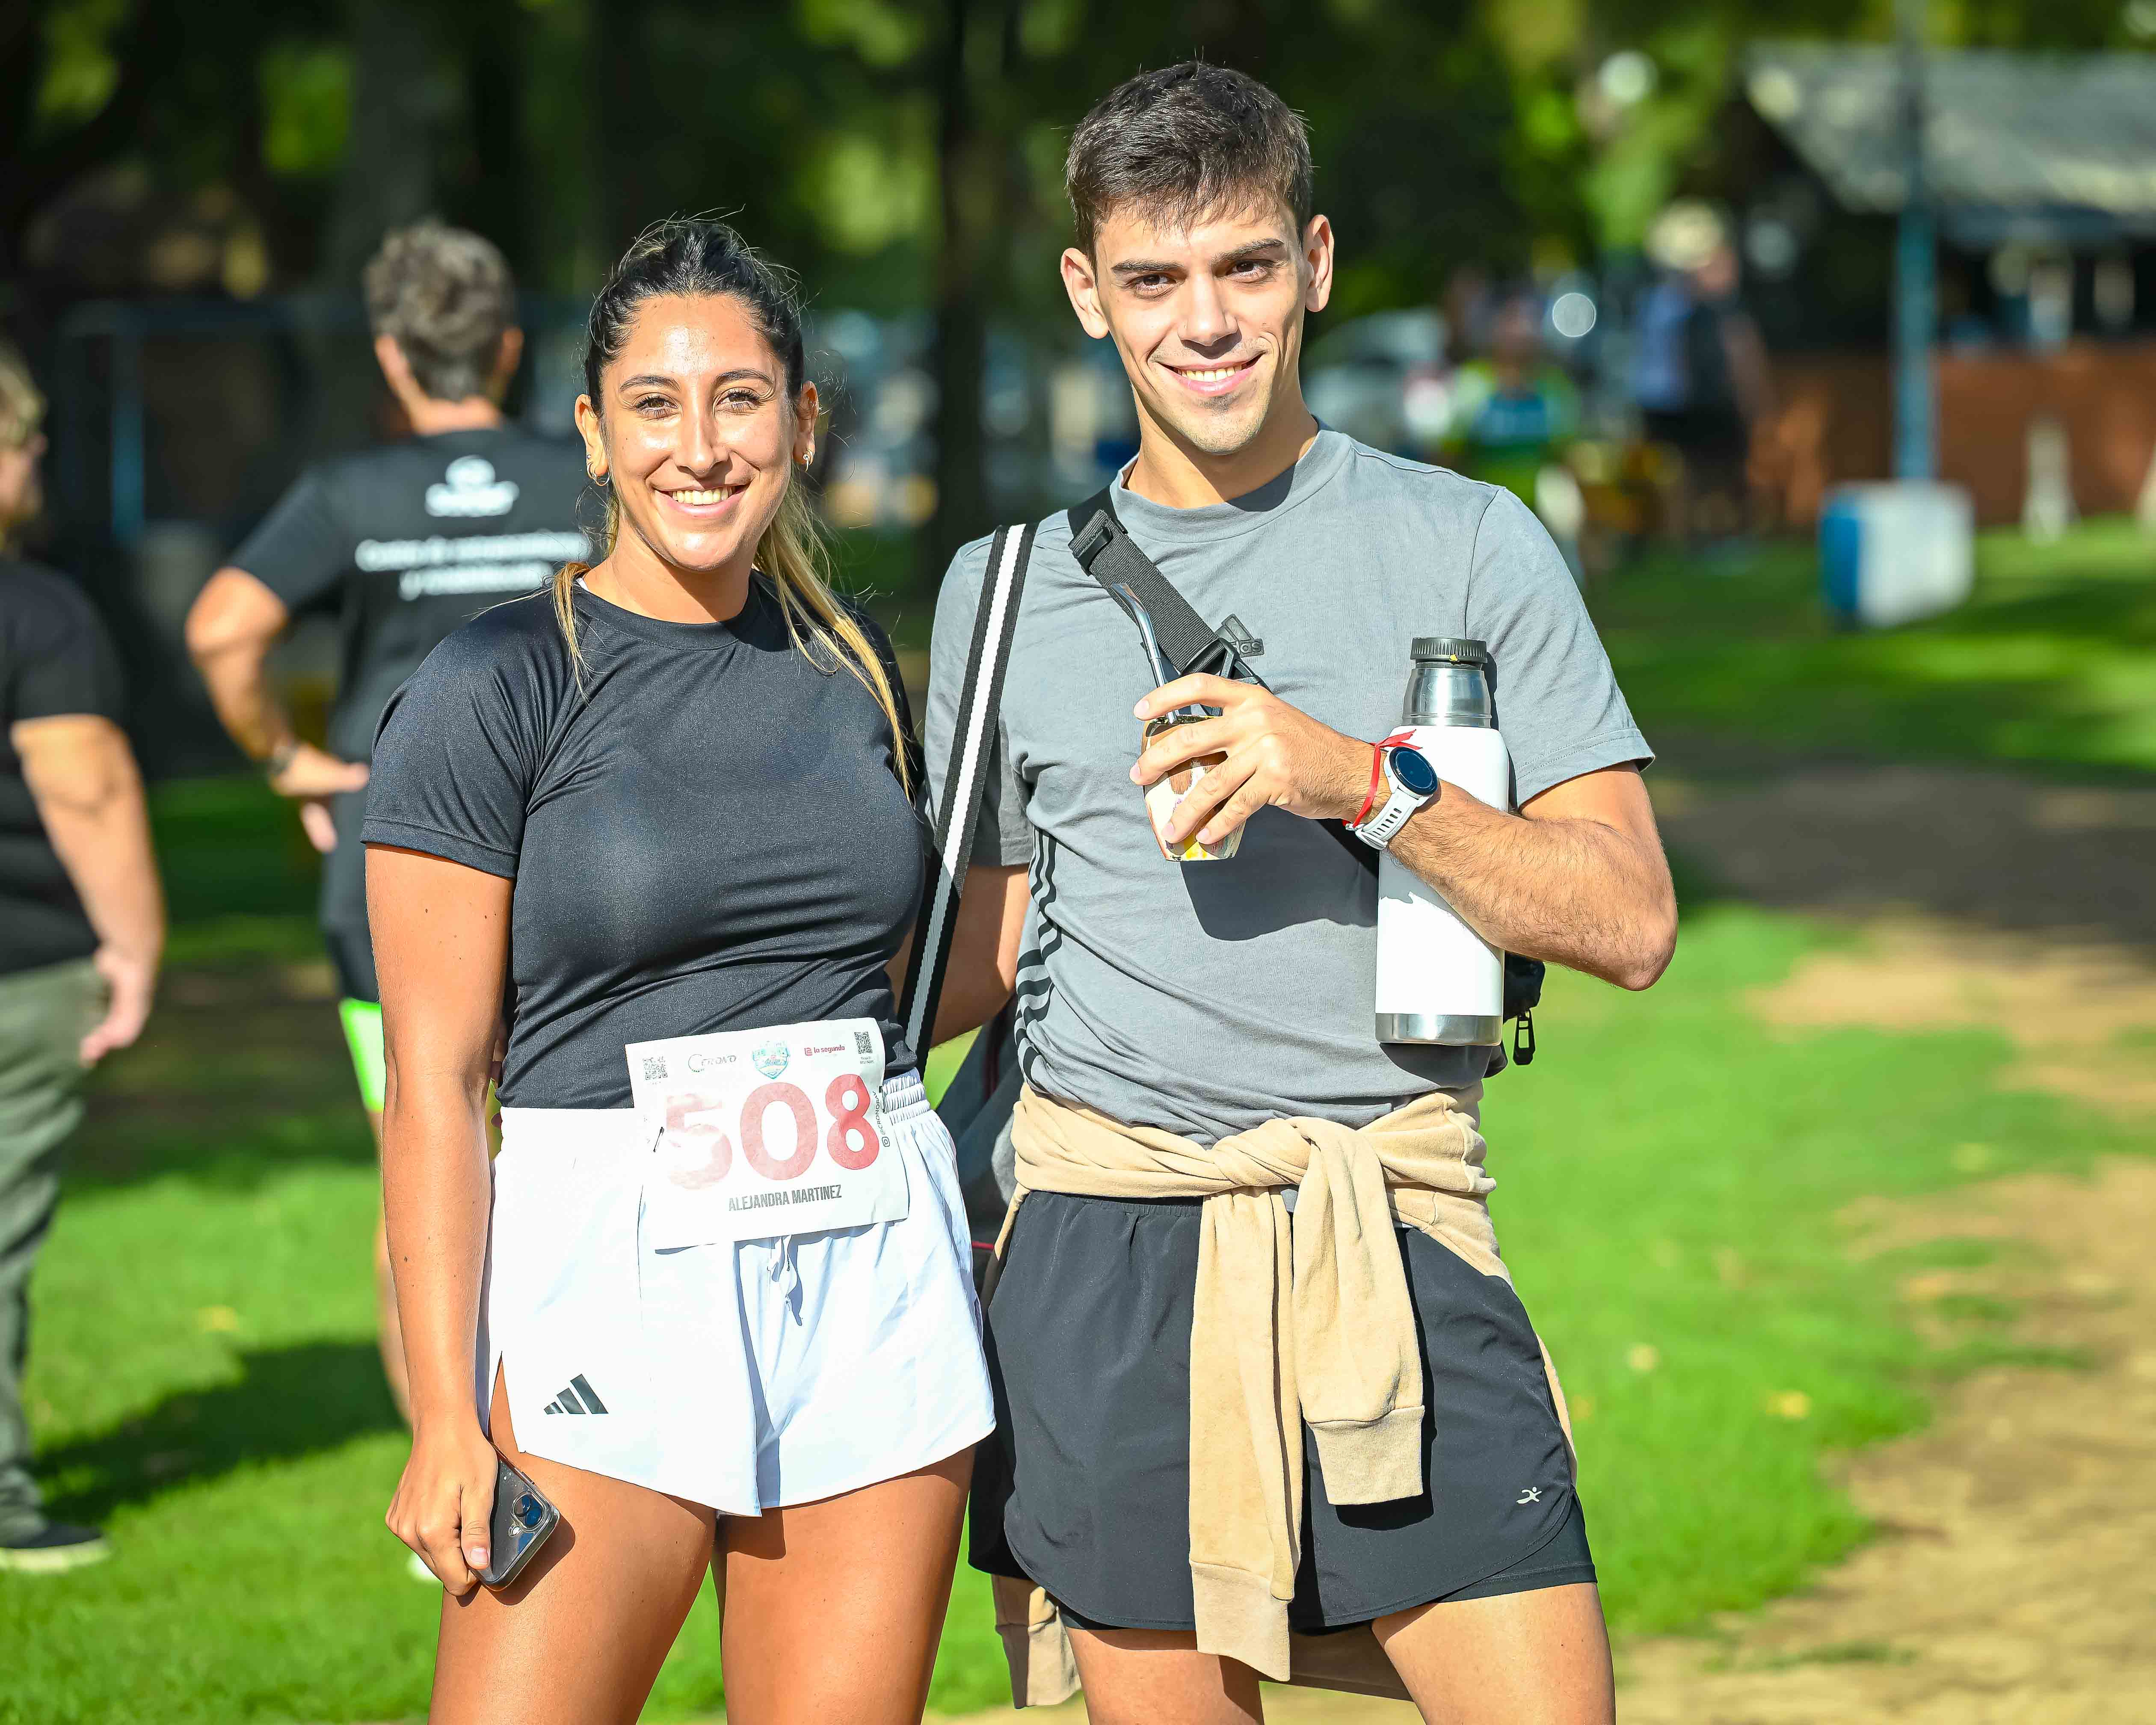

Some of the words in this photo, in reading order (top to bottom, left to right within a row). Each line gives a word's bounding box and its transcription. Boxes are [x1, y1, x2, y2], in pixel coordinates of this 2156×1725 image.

[821, 1045, 845, 1053] segunda
[666, 1073, 880, 1190] 508
[729, 1191, 790, 1211] ALEJANDRA
[791, 1184, 842, 1204] MARTINEZ
